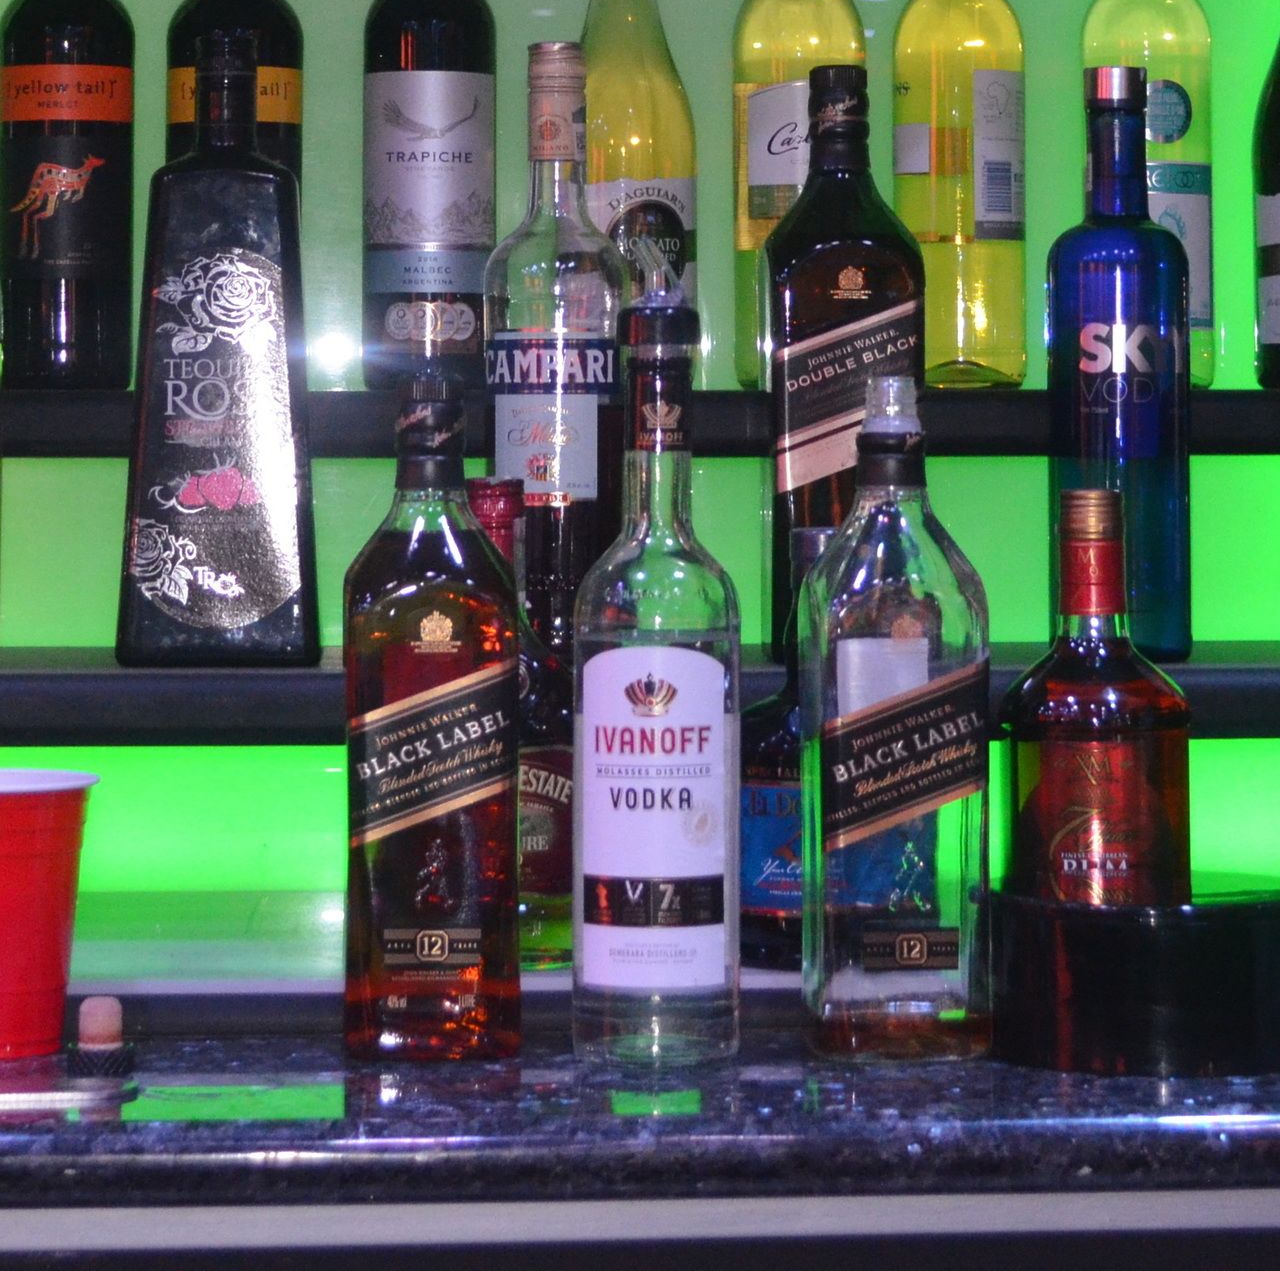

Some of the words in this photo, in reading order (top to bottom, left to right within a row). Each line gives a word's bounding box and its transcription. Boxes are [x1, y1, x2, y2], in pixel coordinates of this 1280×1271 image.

[385, 151, 473, 163] TRAPICHE
[403, 266, 452, 274] MALBEC
[486, 348, 615, 384] CAMPARI
[786, 357, 857, 392] DOUBLE
[862, 334, 919, 363] BLACK
[807, 344, 854, 370] JOHNNIE
[376, 722, 428, 750] JOHNNIE
[429, 703, 479, 727] WALKER
[594, 725, 712, 755] IVANOFF
[851, 722, 904, 752] JOHNNIE
[356, 738, 432, 779] BLACK
[436, 710, 510, 750] LABEL
[832, 739, 909, 783] BLACK
[912, 711, 984, 751] LABEL
[378, 765, 428, 796] Blended
[425, 755, 461, 779] Scotch
[460, 738, 504, 764] Whisky
[596, 766, 652, 776] MOLASSES
[656, 766, 711, 776] DISTILLED
[853, 766, 906, 798] Blended
[935, 739, 978, 765] Whisky
[519, 764, 574, 805] ESTATE
[609, 787, 693, 811] VODKA
[422, 936, 443, 956] 12
[902, 939, 921, 959] 12
